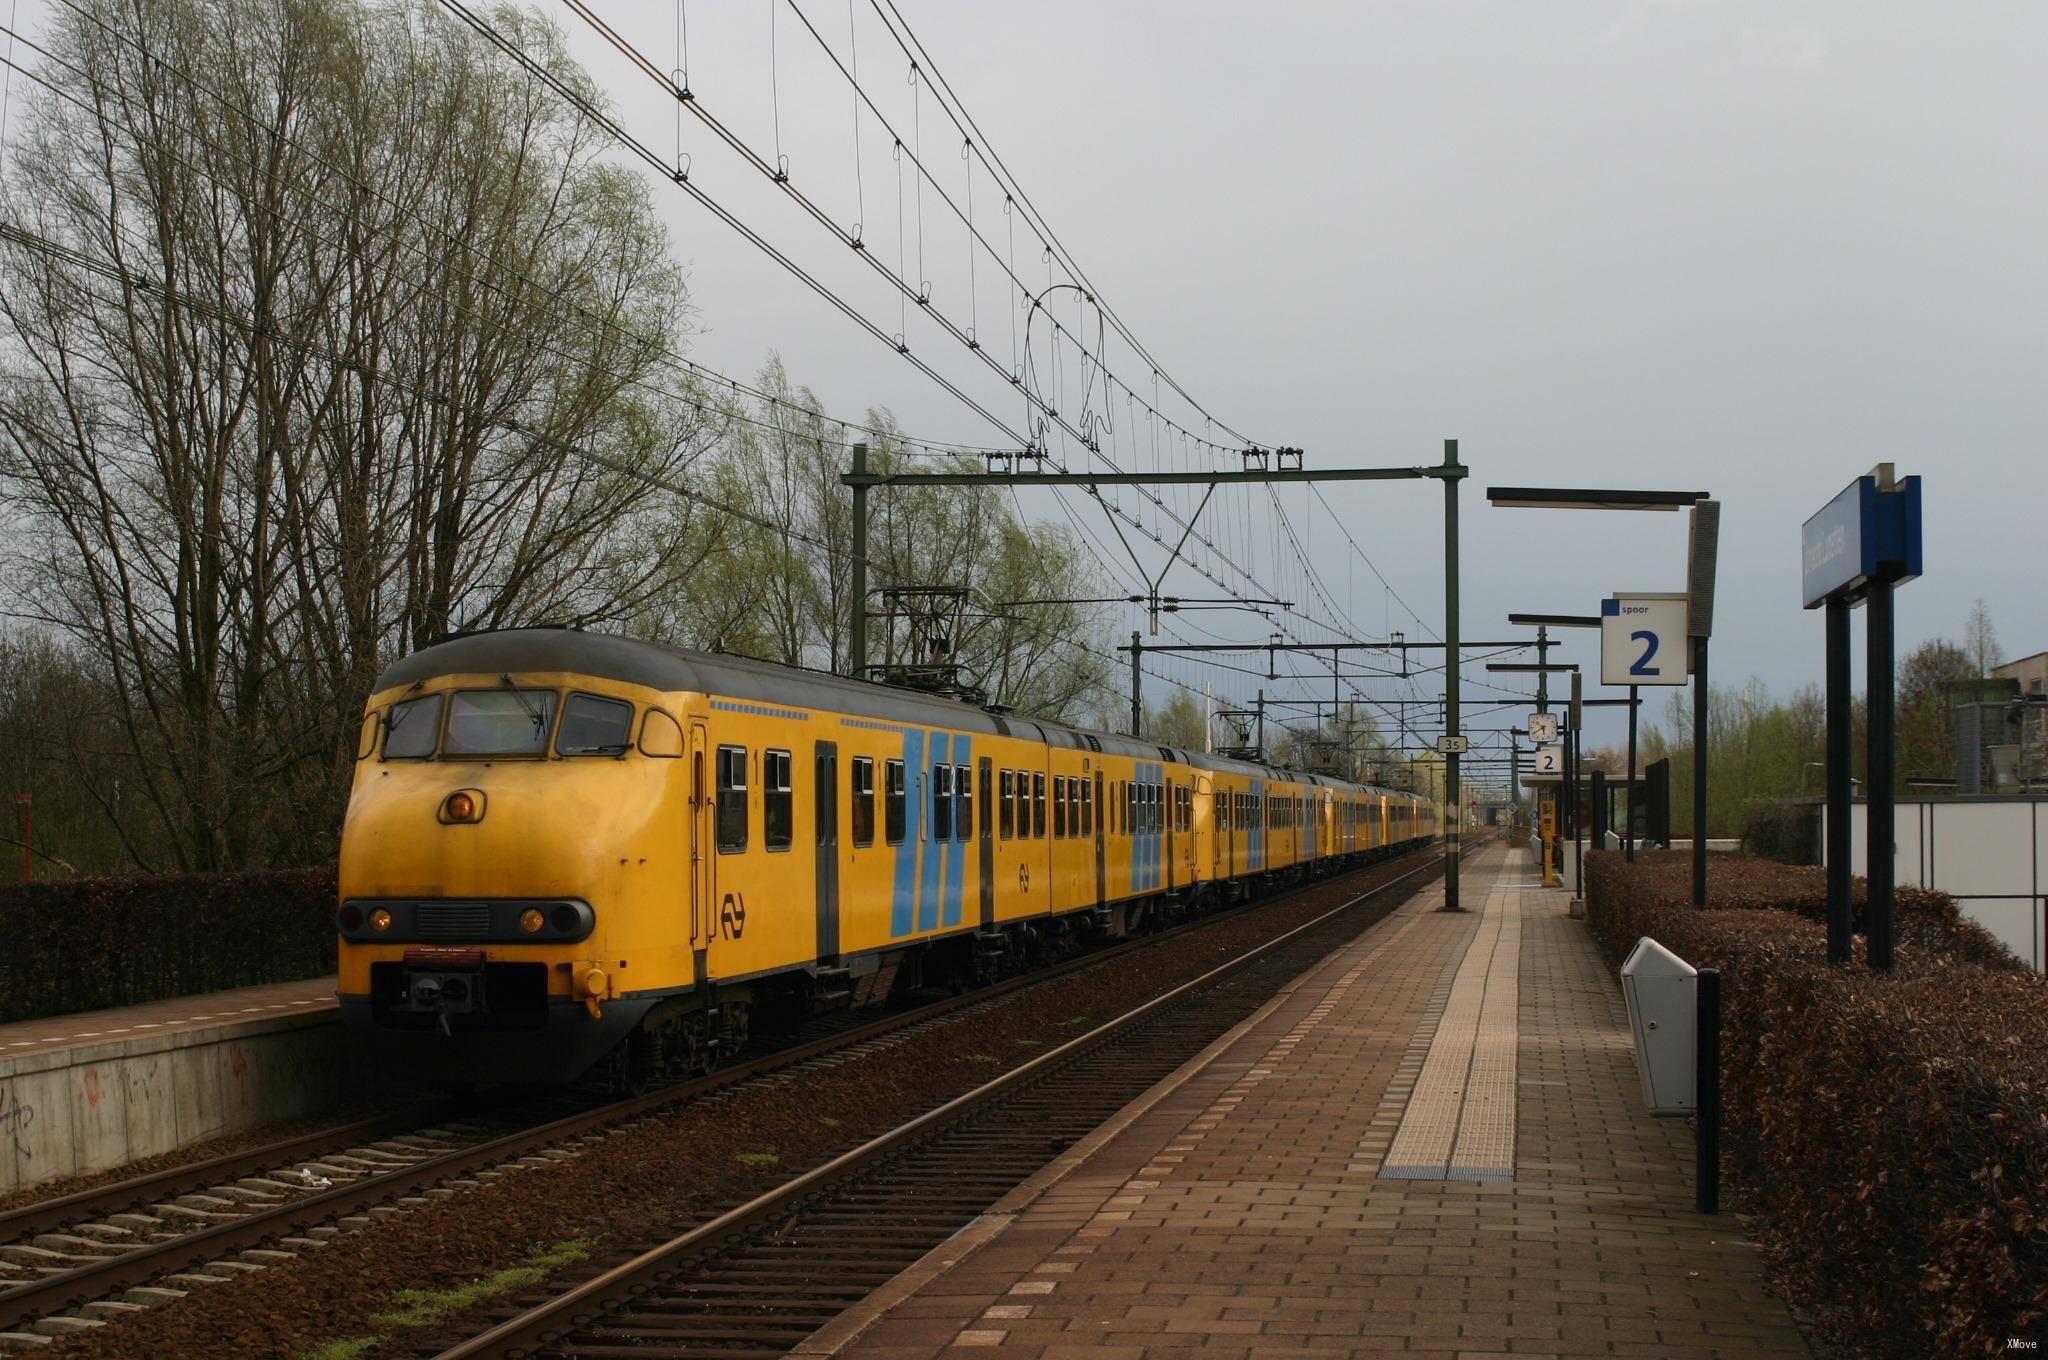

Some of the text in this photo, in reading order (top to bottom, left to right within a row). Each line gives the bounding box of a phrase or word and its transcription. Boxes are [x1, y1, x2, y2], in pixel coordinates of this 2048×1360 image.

[1622, 607, 1648, 615] spoor
[1629, 630, 1660, 676] 2
[1544, 755, 1554, 770] 2
